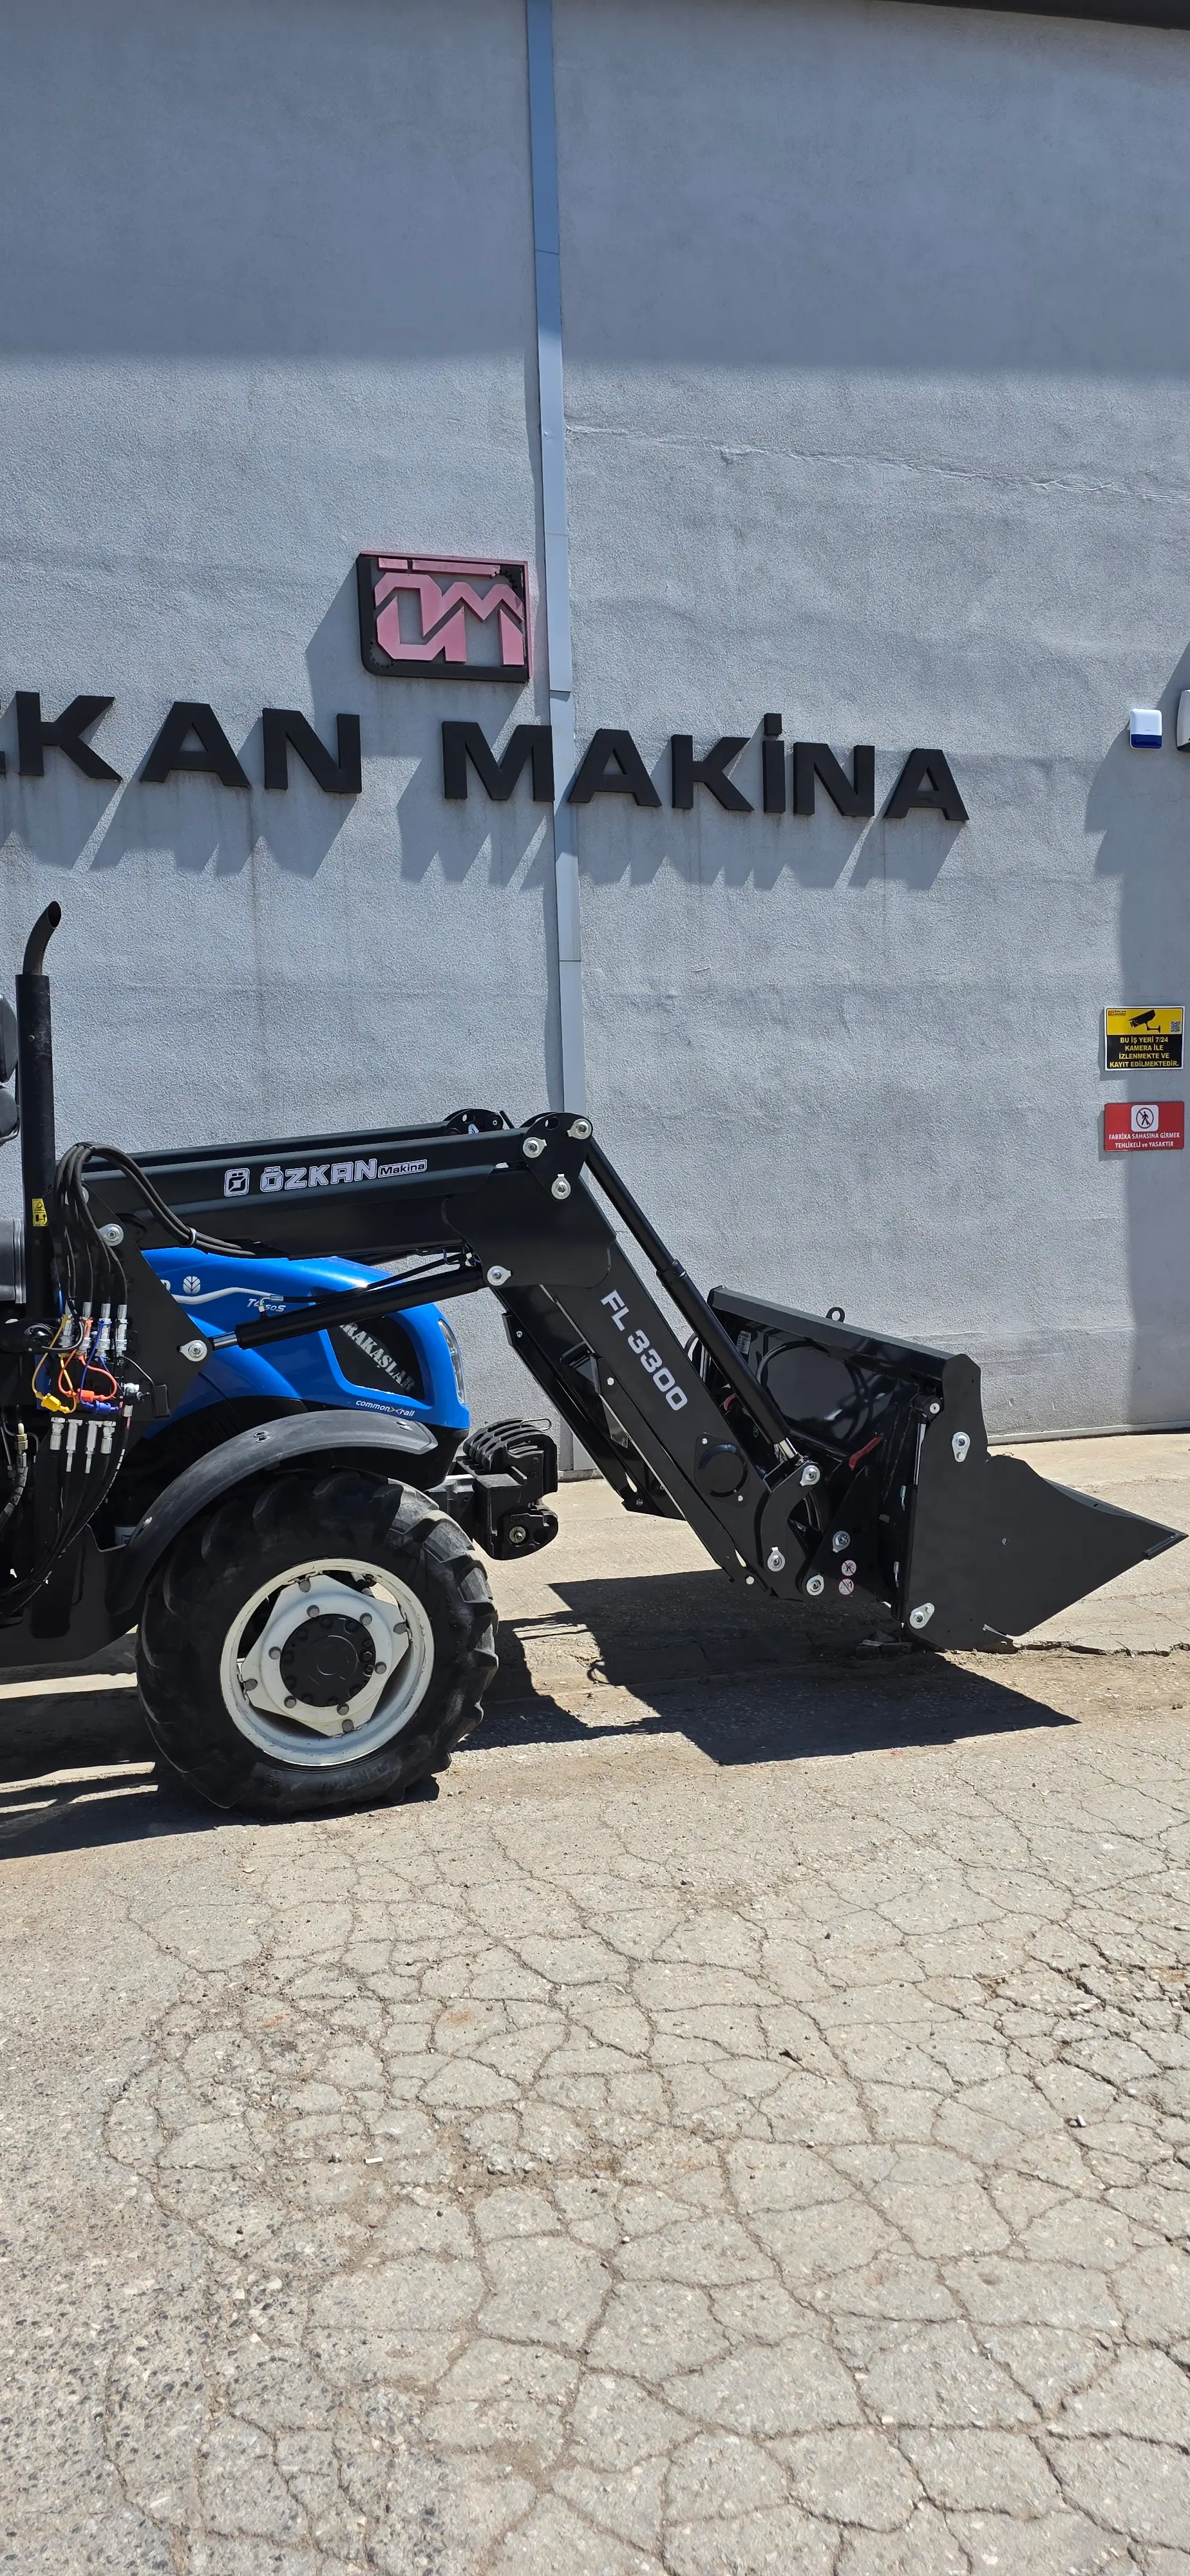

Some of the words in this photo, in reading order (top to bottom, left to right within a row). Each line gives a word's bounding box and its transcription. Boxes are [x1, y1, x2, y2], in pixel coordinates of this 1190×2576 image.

[0, 690, 363, 793] KAN
[441, 712, 970, 821] MAKİNA
[1131, 1036, 1138, 1044] İŞ
[260, 1159, 377, 1192] ÖZKAN
[380, 1162, 425, 1176] Makina
[600, 1289, 629, 1331] FL
[627, 1329, 688, 1411] 3300
